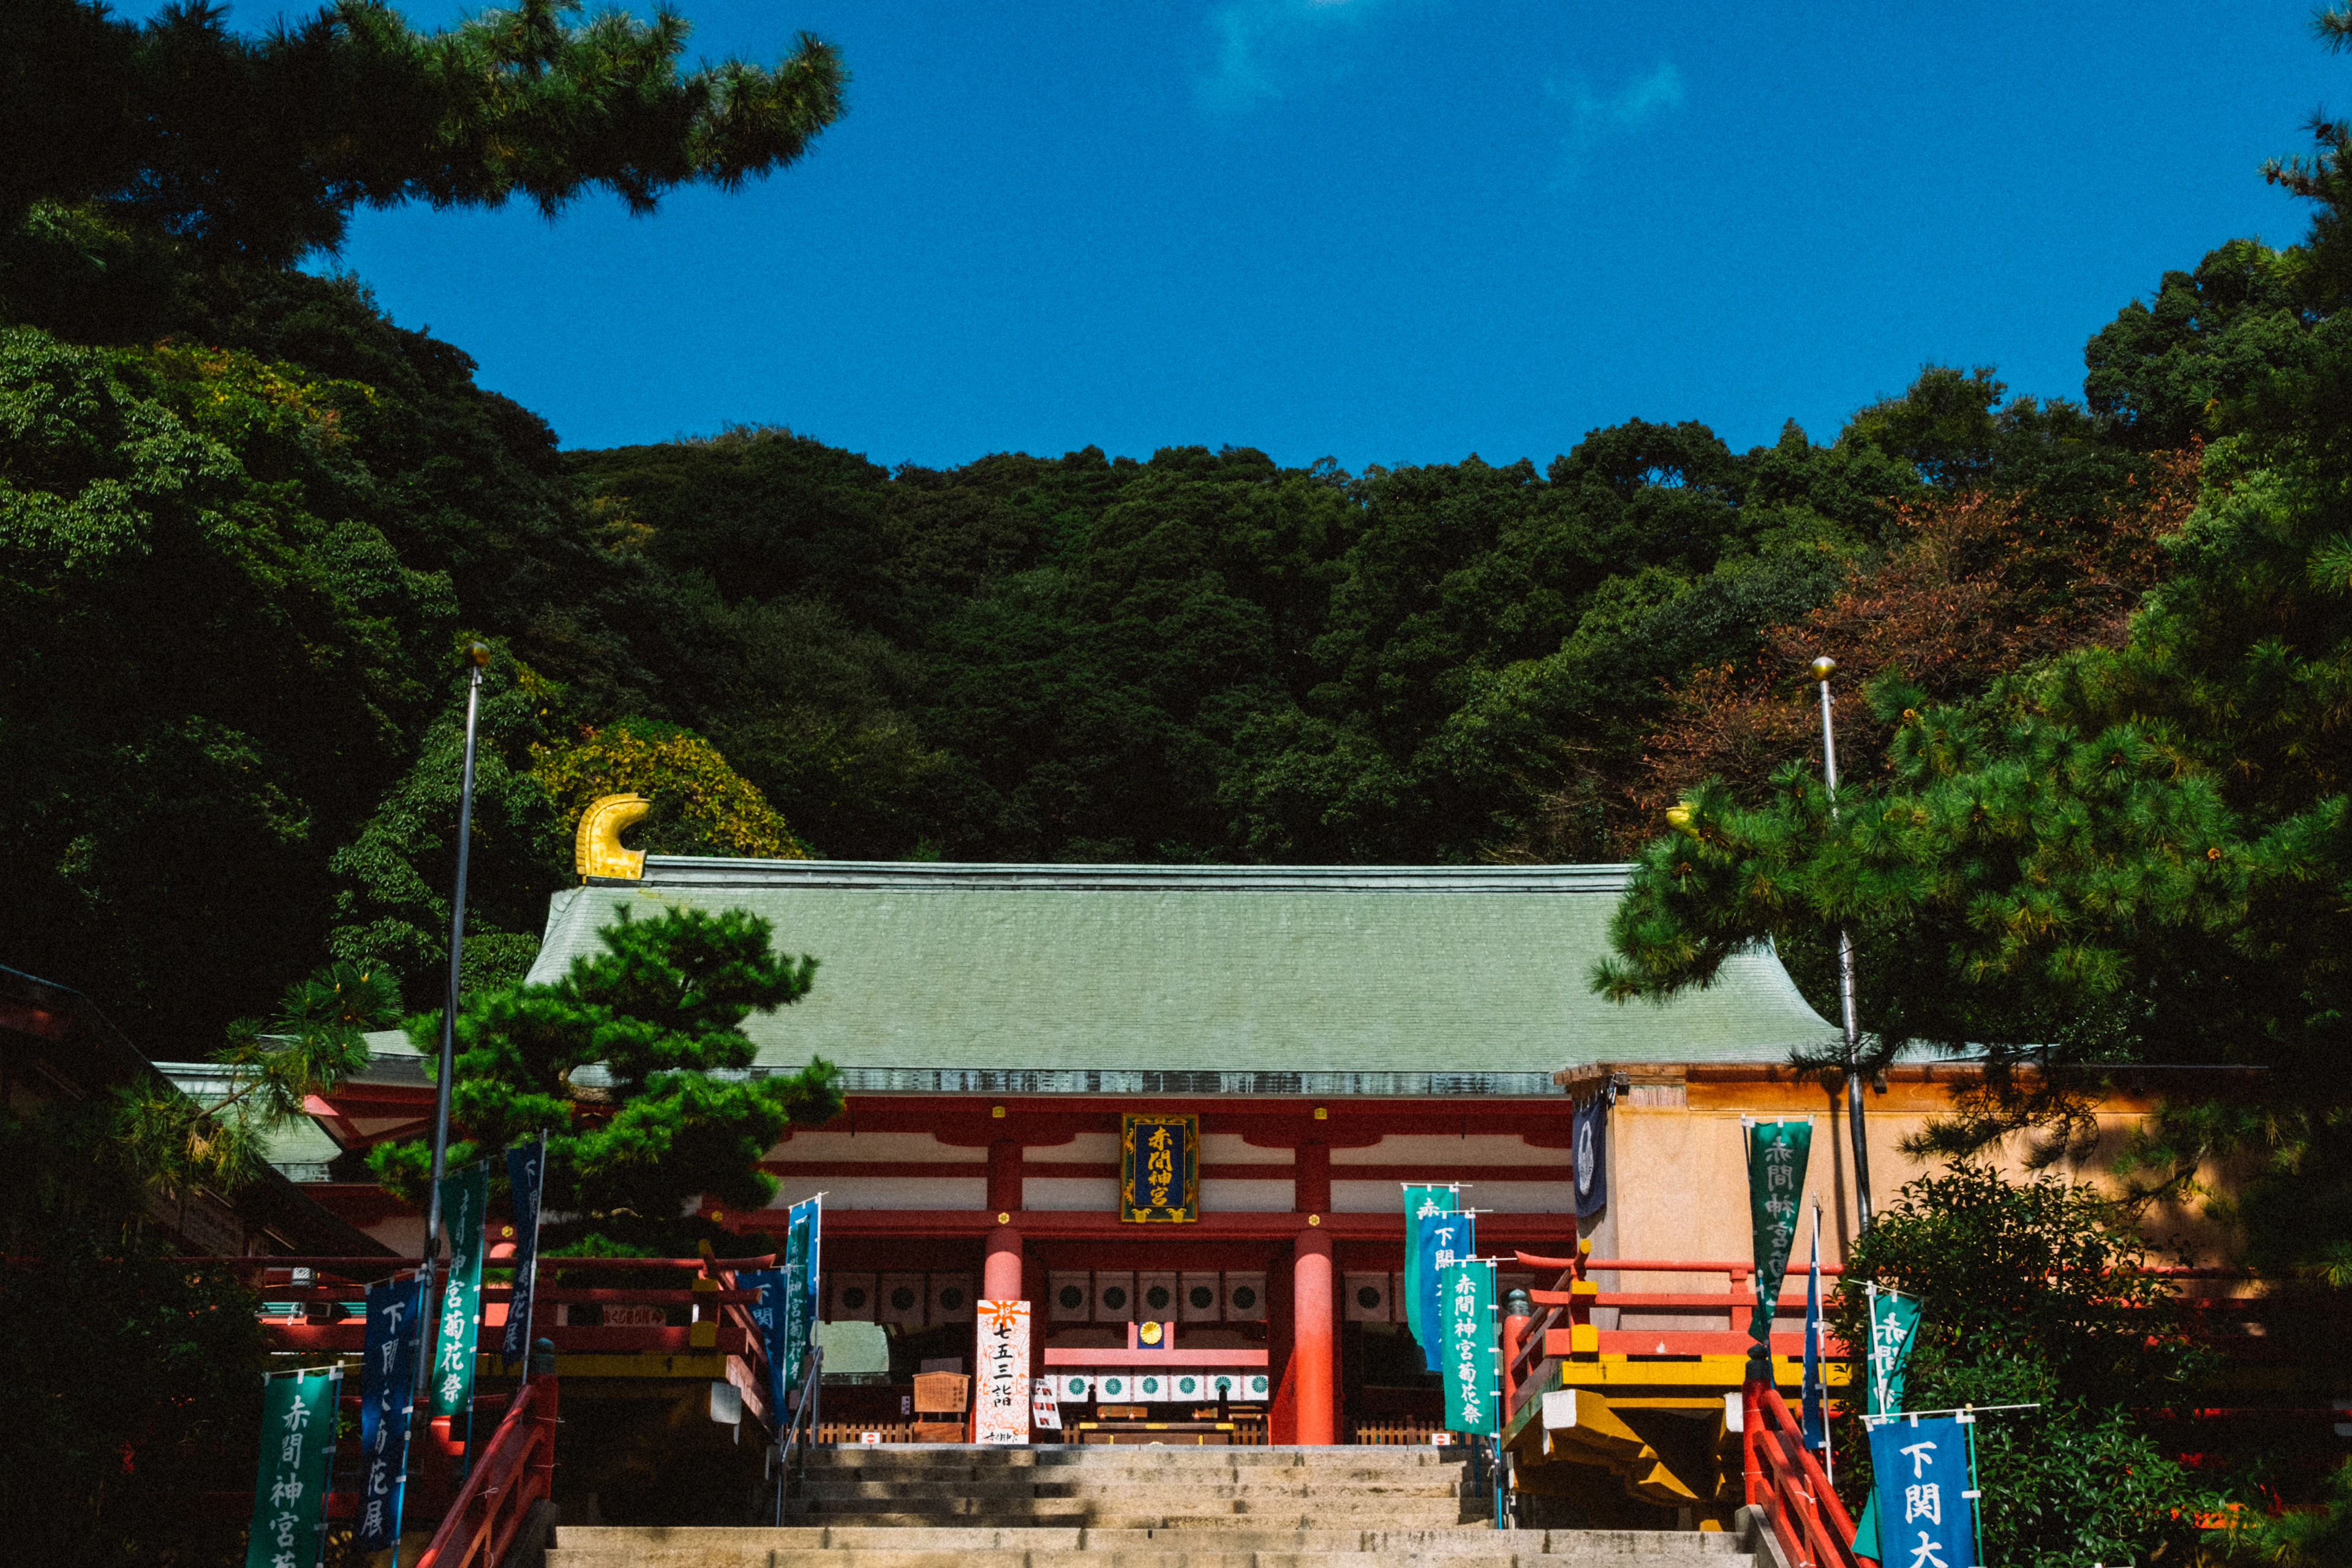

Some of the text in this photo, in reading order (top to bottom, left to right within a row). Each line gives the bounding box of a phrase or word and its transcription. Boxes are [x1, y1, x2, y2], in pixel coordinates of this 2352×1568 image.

[1147, 1125, 1173, 1206] 赤間神宮
[992, 1322, 1013, 1408] 七五三詣
[1454, 1274, 1482, 1425] 赤間神宮菊花祭
[1899, 1441, 1949, 1568] 下関大
